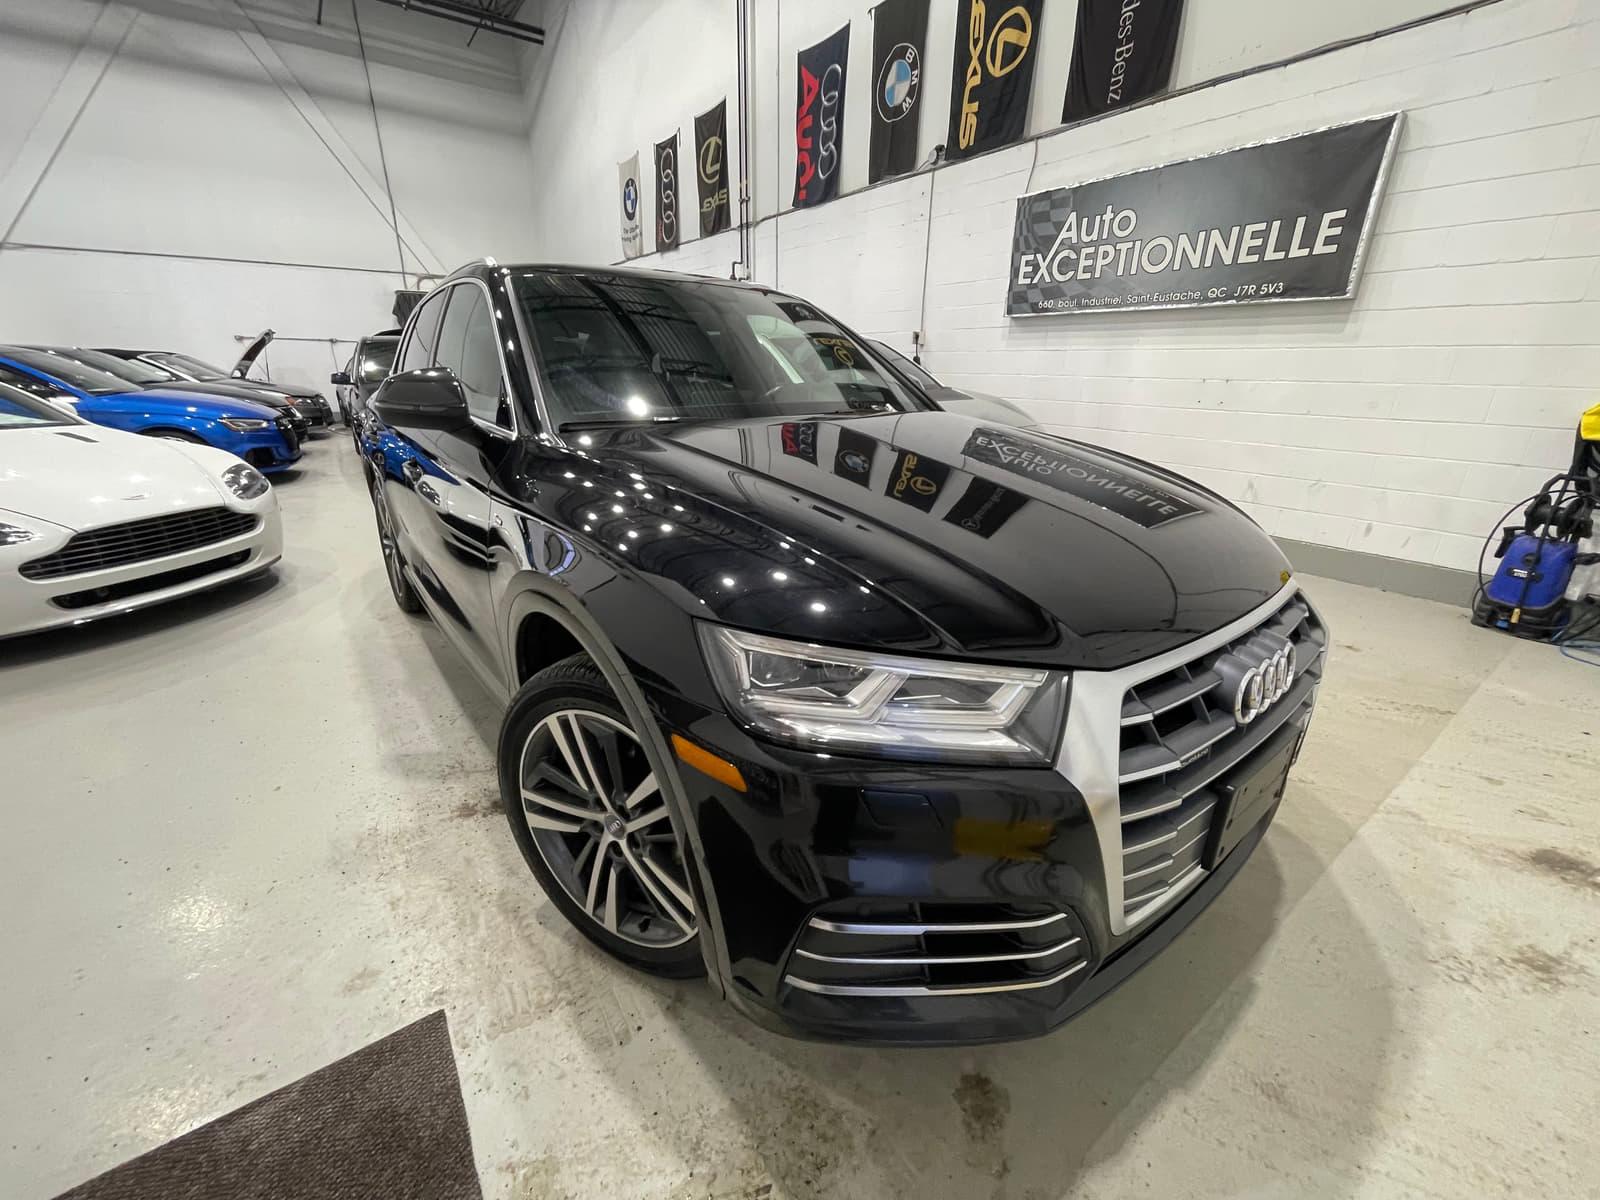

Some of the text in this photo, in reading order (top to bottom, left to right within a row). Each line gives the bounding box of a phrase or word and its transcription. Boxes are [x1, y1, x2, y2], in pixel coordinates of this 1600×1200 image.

[959, 0, 986, 150] EXUS
[1017, 208, 1348, 285] EXCEPTIONNELLE
[1060, 203, 1138, 247] Auto
[1207, 287, 1228, 299] QC
[1233, 285, 1258, 297] J7R
[1260, 282, 1284, 295] 5V3
